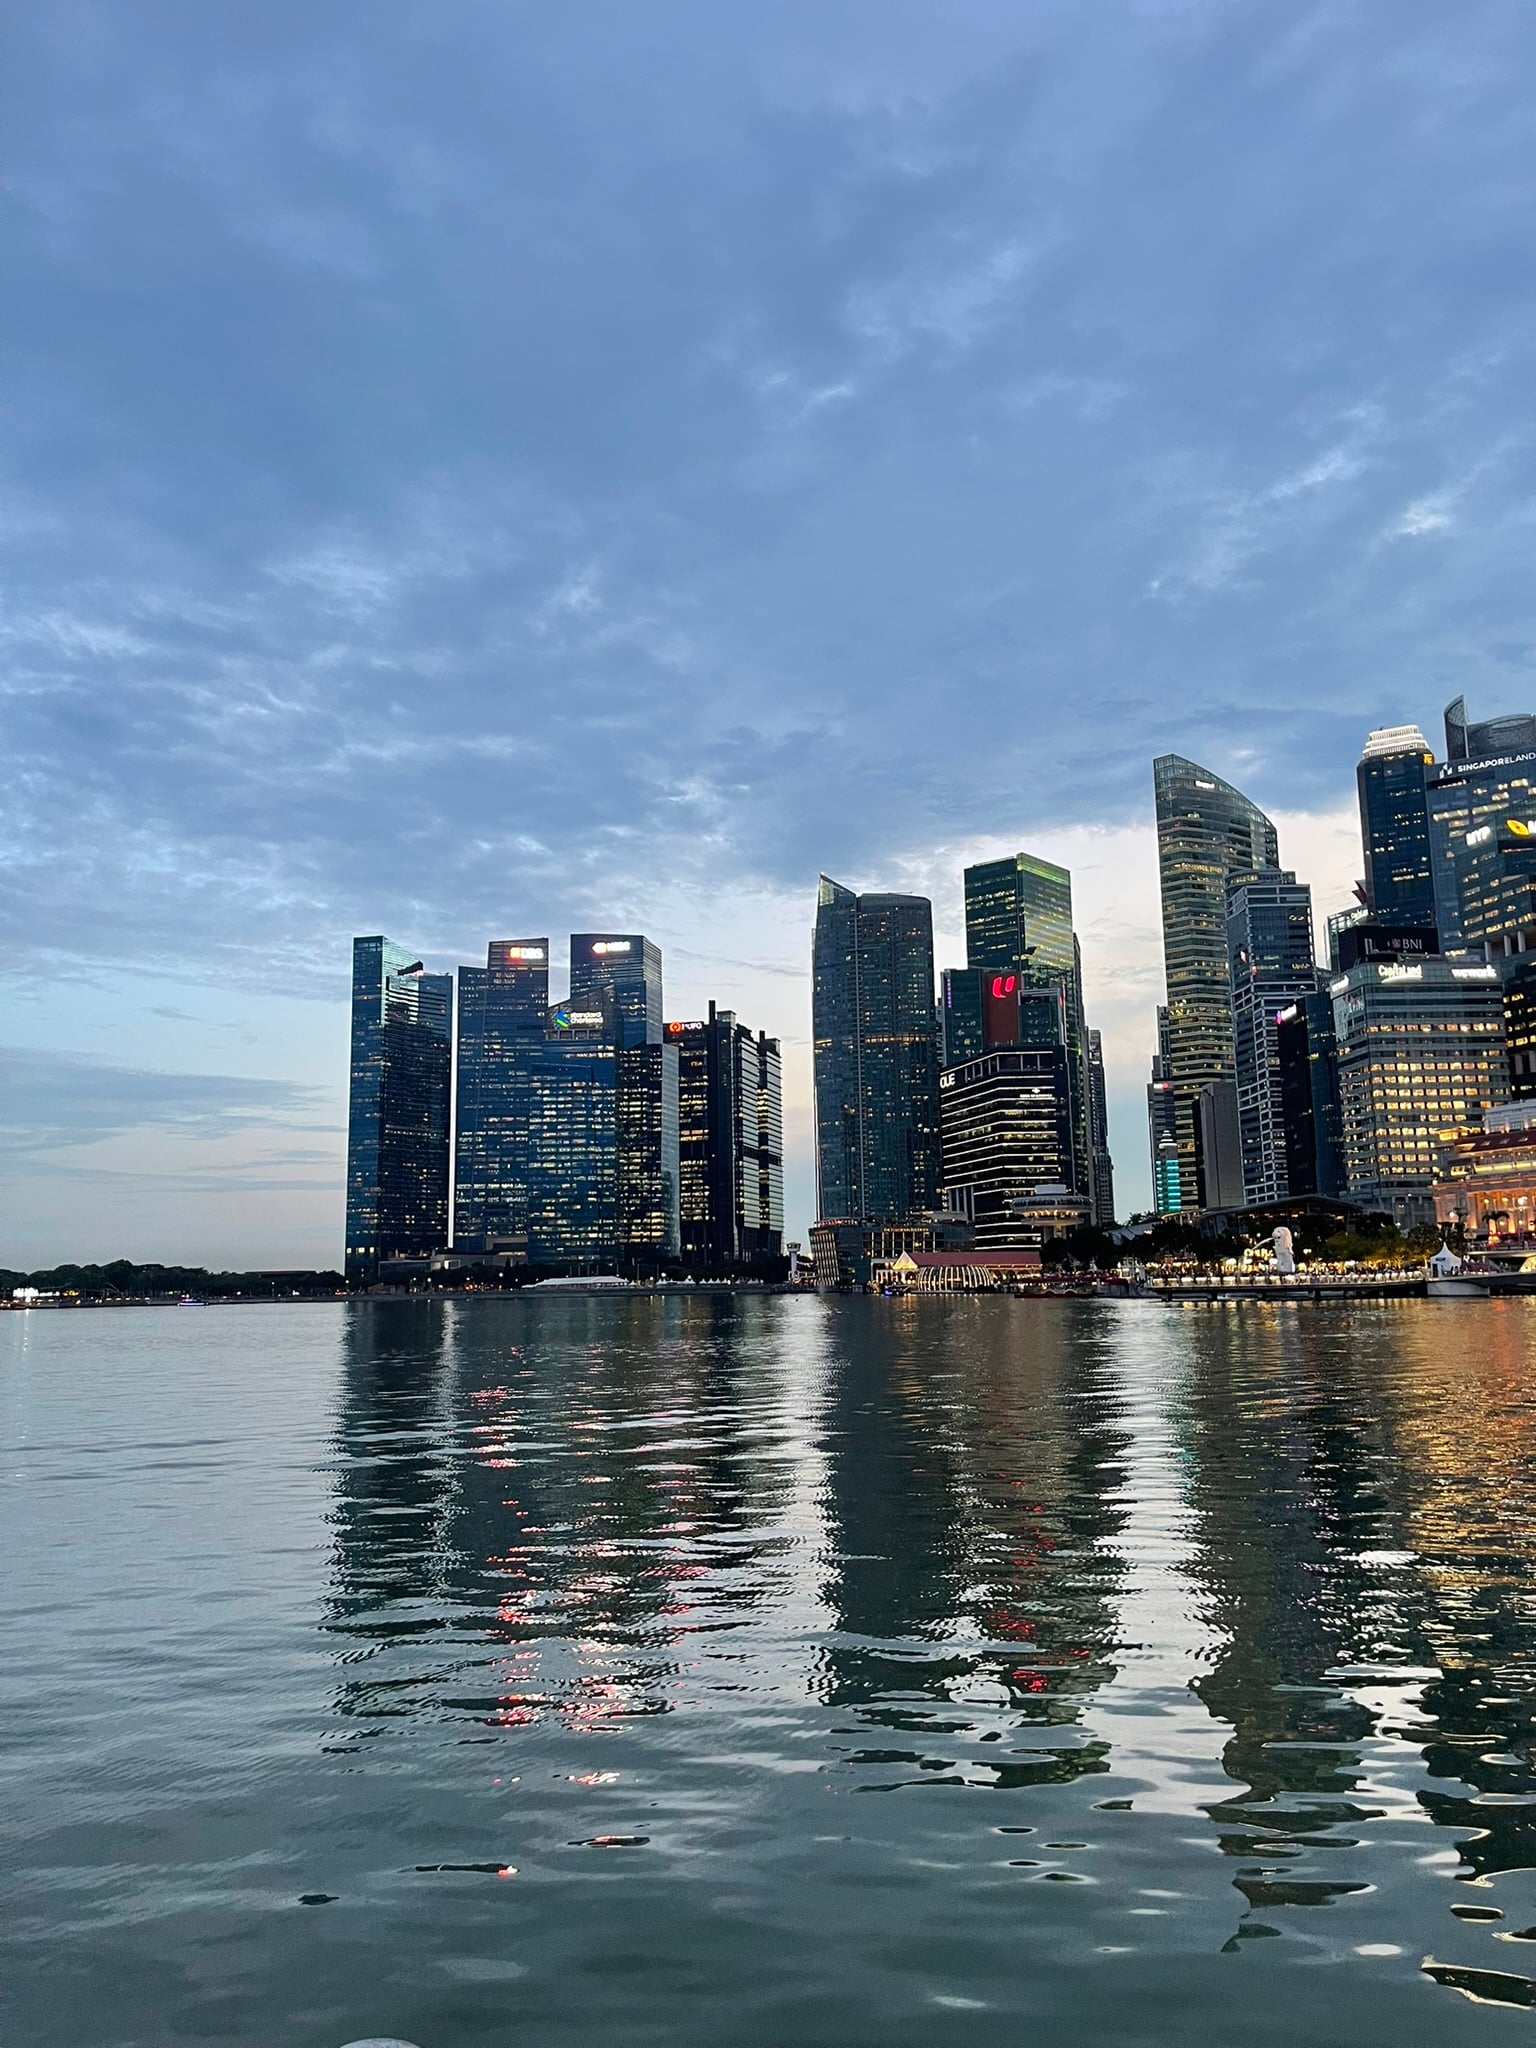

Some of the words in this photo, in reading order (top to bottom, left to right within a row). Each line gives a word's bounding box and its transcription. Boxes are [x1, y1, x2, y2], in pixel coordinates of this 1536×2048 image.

[1457, 752, 1536, 773] SINGAPORELAND
[1402, 938, 1422, 950] BNI
[940, 1073, 956, 1088] OUE
